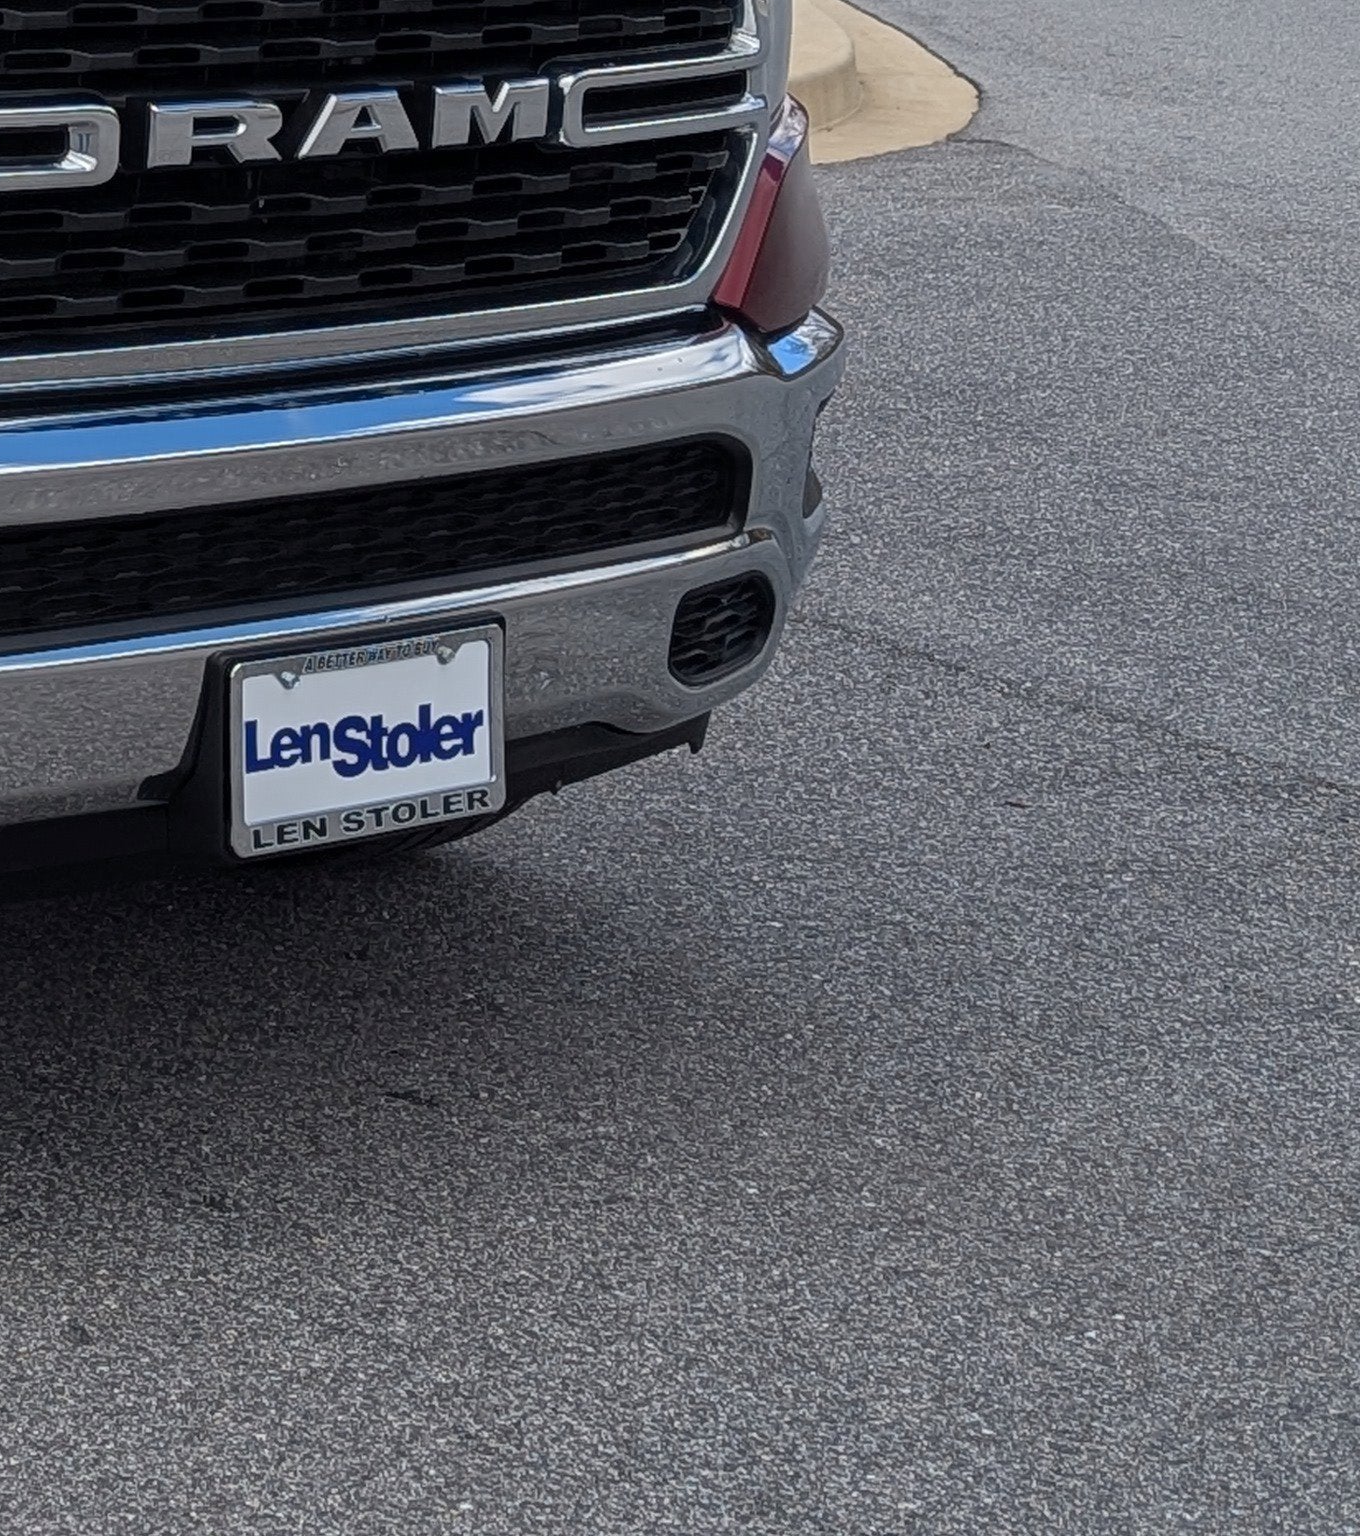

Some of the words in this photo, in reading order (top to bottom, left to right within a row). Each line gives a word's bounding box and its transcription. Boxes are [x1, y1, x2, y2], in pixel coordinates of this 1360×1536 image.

[146, 76, 550, 169] RAM
[317, 650, 366, 670] BETTER
[252, 817, 328, 850] LEN
[342, 789, 490, 833] STOLER
